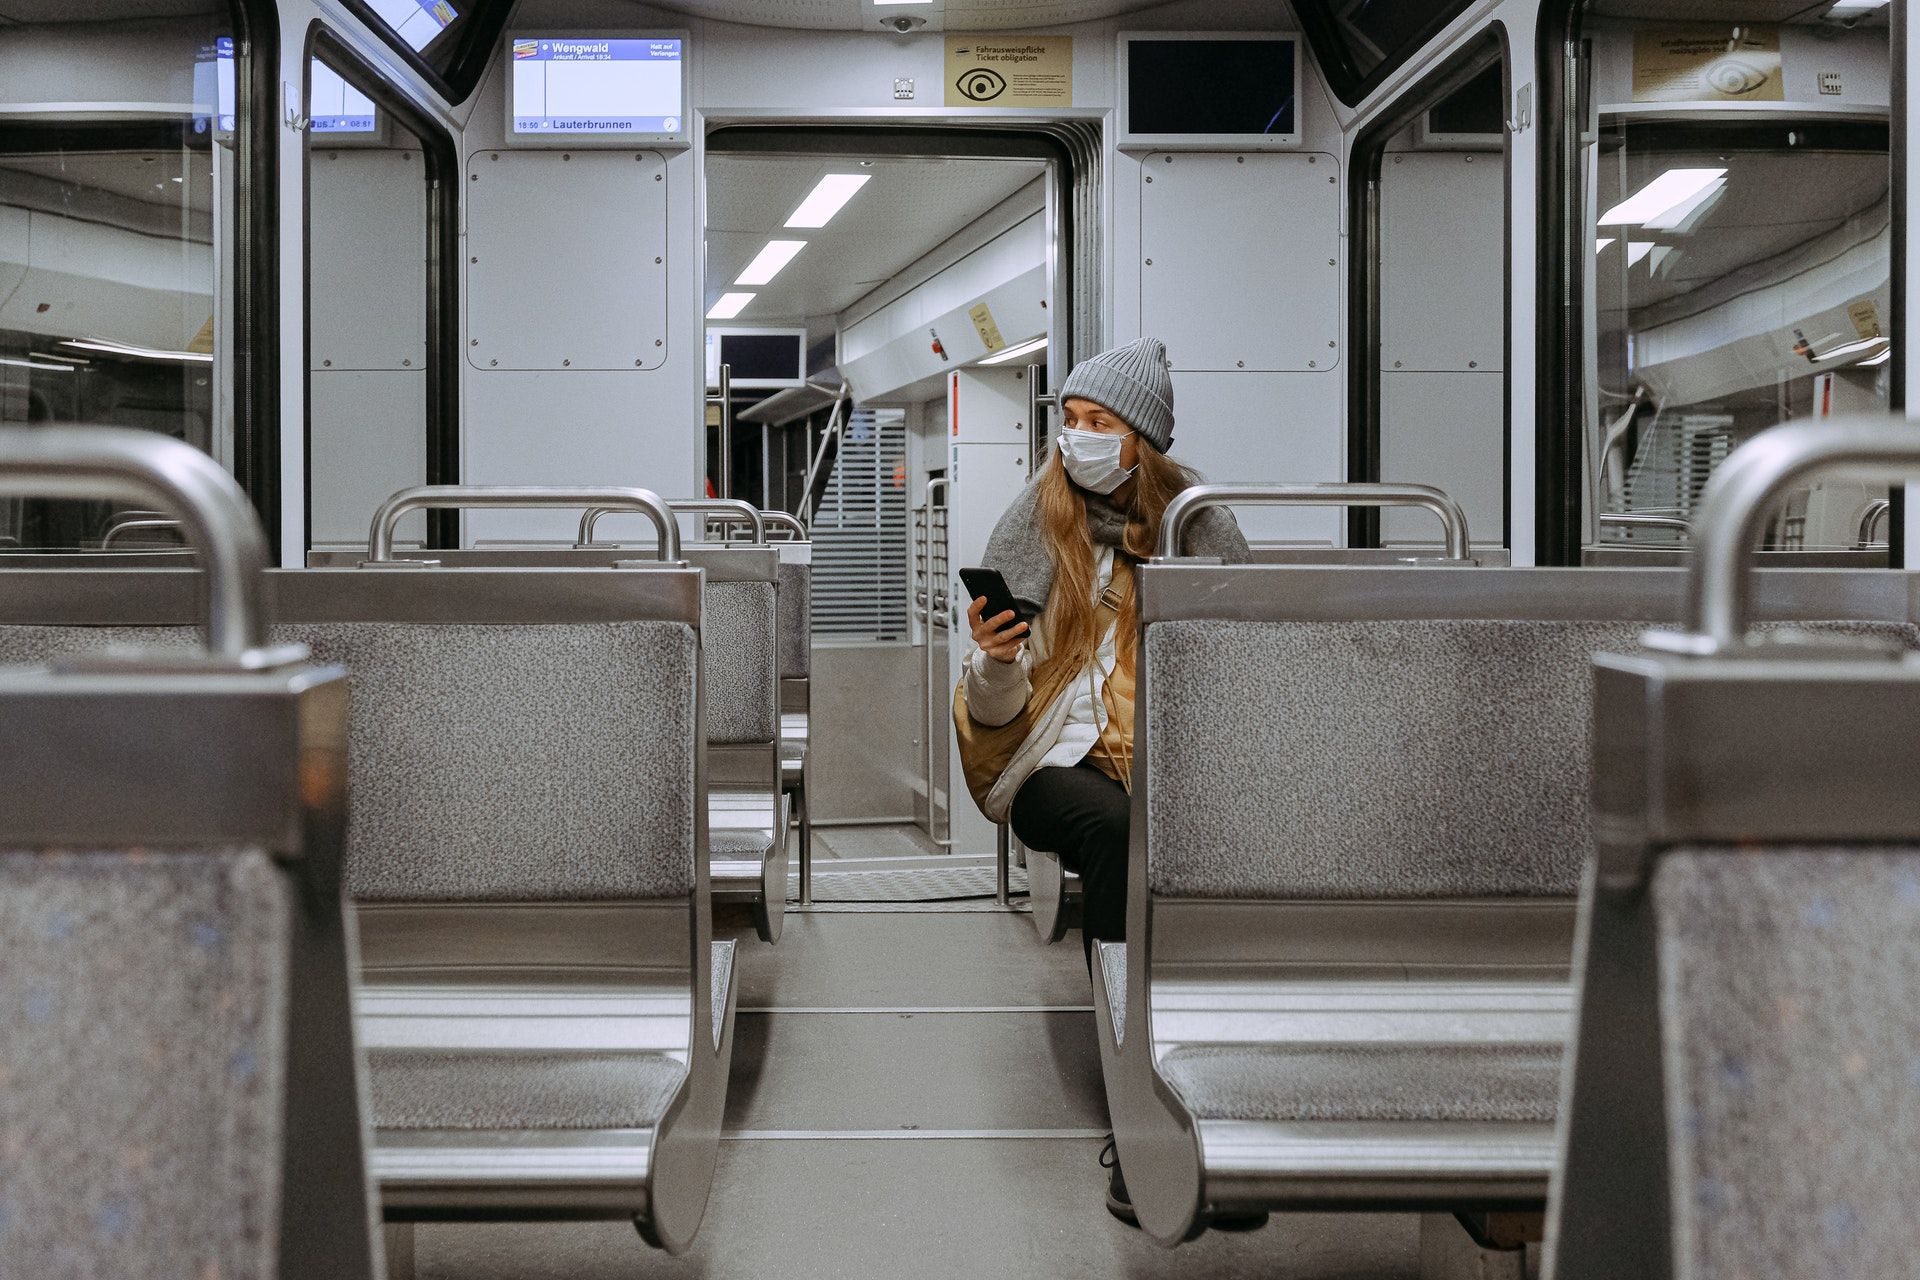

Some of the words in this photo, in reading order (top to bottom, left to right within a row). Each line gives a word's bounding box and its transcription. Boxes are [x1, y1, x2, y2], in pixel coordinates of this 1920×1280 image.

[552, 43, 609, 54] Wengwald
[976, 45, 1045, 54] Fahrausweispflicht
[1000, 54, 1038, 63] obligation
[553, 120, 632, 129] Lauterbrunnen
